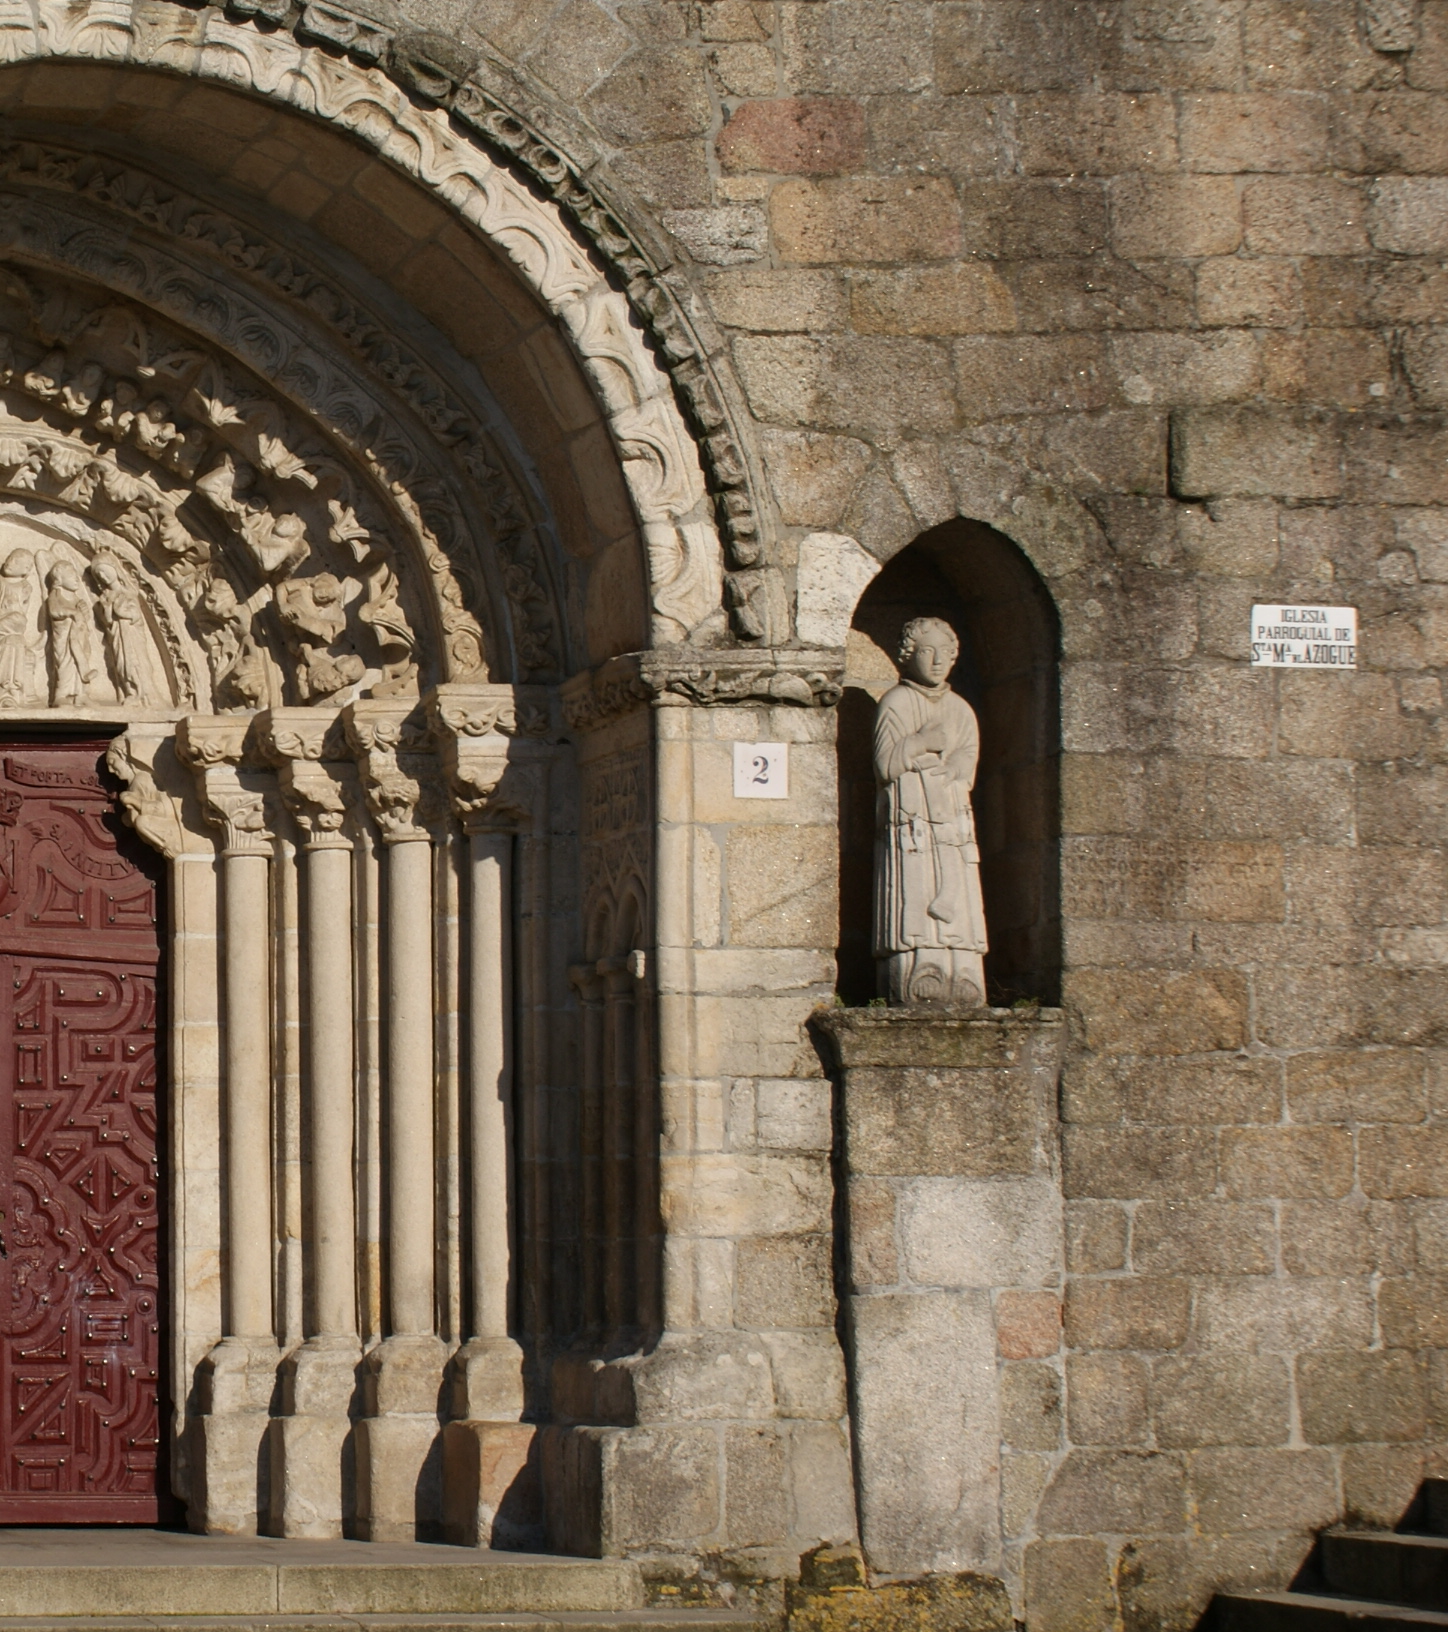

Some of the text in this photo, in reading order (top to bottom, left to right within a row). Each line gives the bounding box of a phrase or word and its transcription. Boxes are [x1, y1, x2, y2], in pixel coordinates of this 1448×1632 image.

[1281, 609, 1328, 624] IGLESIA
[1258, 625, 1351, 641] PARROQUIAL DE
[1304, 643, 1356, 665] AZOGUE
[752, 755, 769, 784] 2
